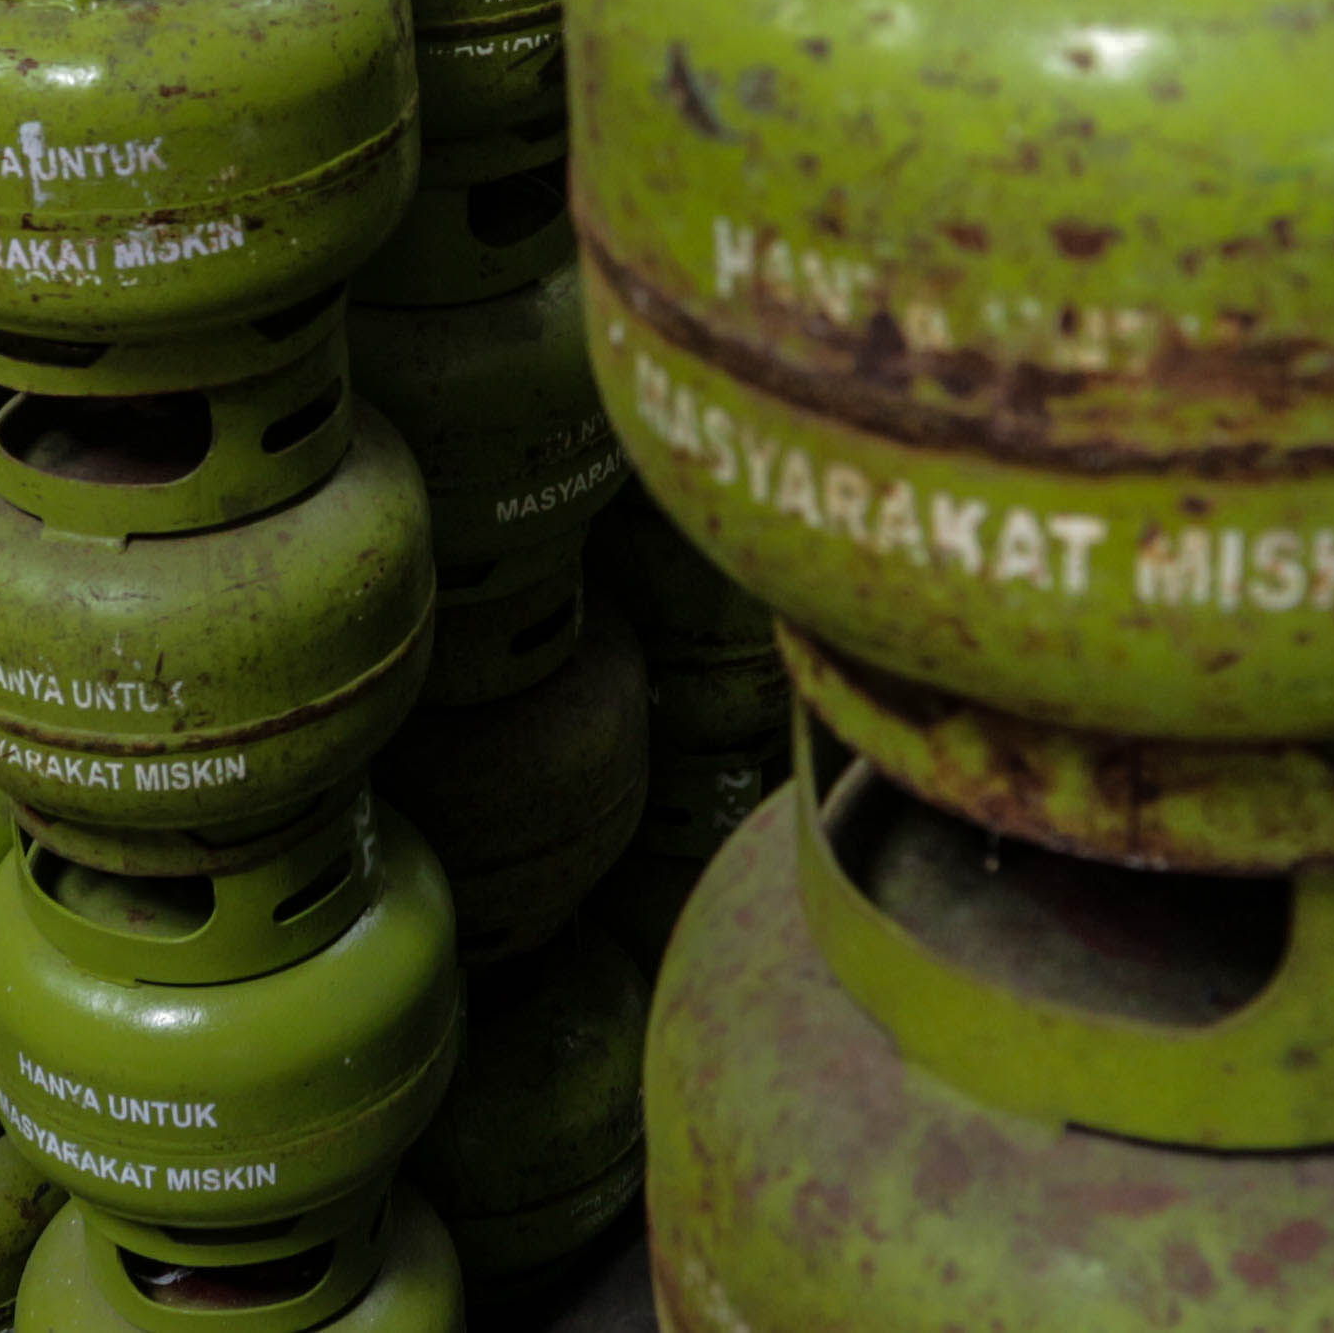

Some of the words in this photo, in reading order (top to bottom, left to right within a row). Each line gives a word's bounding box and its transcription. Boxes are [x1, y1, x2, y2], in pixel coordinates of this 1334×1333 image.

[25, 134, 167, 183] UNTUK
[114, 213, 247, 270] MISKIN
[633, 353, 1111, 598] MASYARAKAT
[134, 753, 248, 793] MISKIN
[18, 1050, 101, 1115] HANYA
[107, 1093, 218, 1129] UNTUK
[166, 1162, 277, 1194] MISKIN
